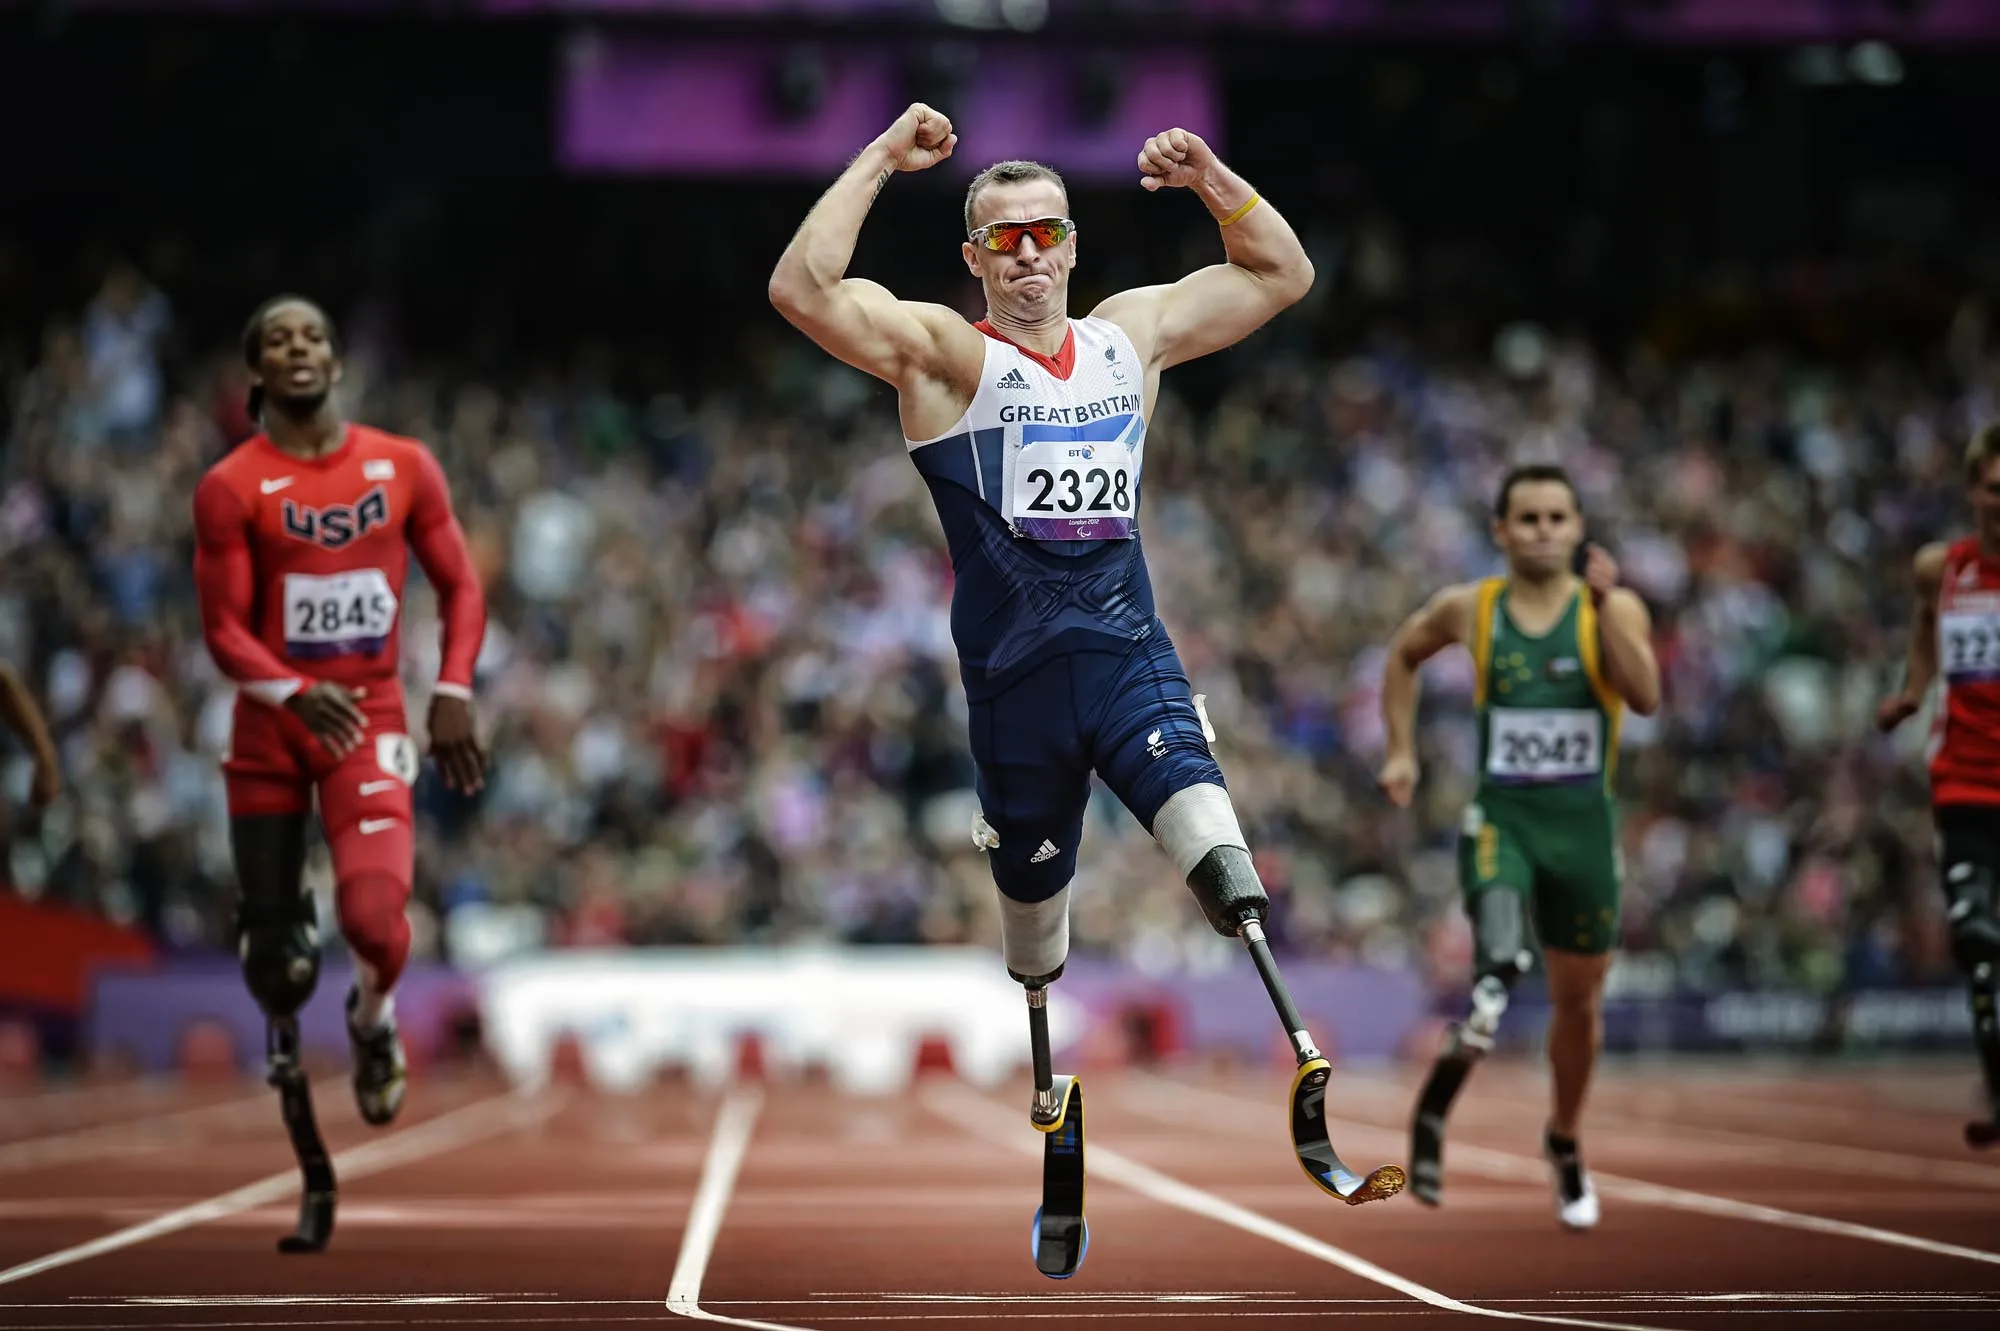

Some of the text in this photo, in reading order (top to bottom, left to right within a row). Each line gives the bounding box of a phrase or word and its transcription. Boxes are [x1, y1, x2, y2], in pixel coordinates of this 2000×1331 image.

[997, 381, 1030, 389] adidas
[1000, 394, 1140, 424] GREAT BRITAIN
[1068, 449, 1081, 457] BT
[1026, 468, 1130, 512] 2328
[284, 488, 385, 549] USA
[295, 593, 387, 633] 2845
[1501, 730, 1591, 766] 2042
